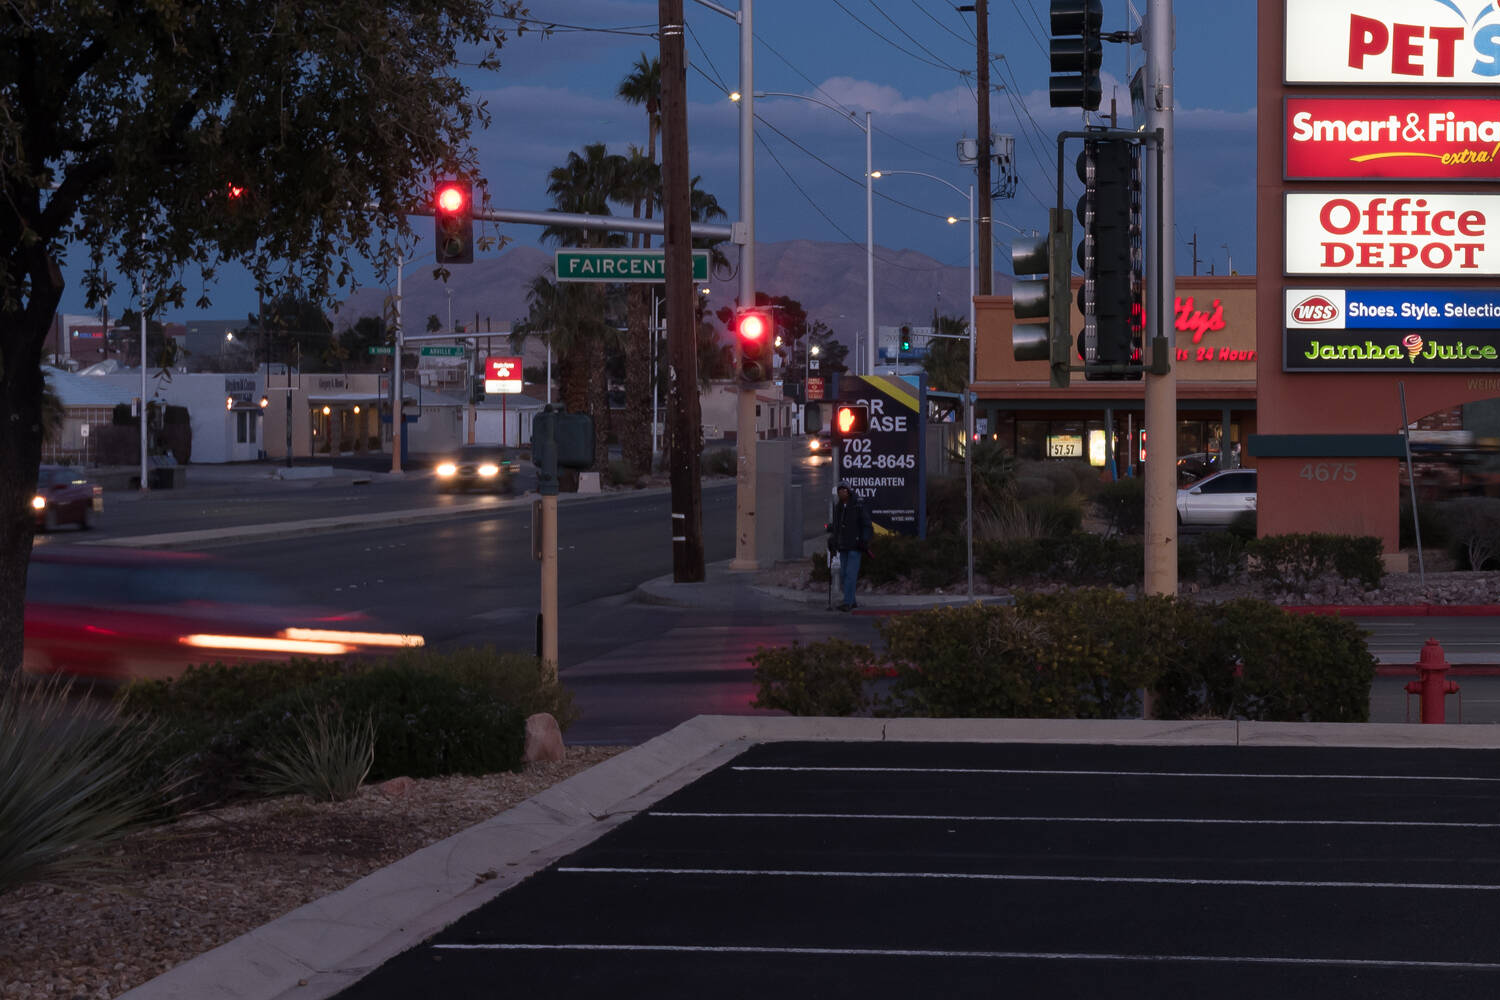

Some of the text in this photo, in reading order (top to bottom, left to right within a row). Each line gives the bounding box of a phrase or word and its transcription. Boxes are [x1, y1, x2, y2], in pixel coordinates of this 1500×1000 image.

[1319, 198, 1487, 237] Office
[1320, 242, 1485, 269] DEPOT
[569, 258, 695, 274] FAIRCENT
[1297, 304, 1334, 320] WSS
[1348, 302, 1398, 317] Shoes.
[1400, 302, 1441, 320] Style.
[1196, 347, 1214, 361] 24
[1218, 346, 1258, 361] Hour
[1304, 340, 1498, 360] Jamba Juice
[869, 416, 908, 432] ASE
[843, 438, 872, 453] 702
[842, 454, 915, 469] 642-8645
[1299, 463, 1358, 482] 4675
